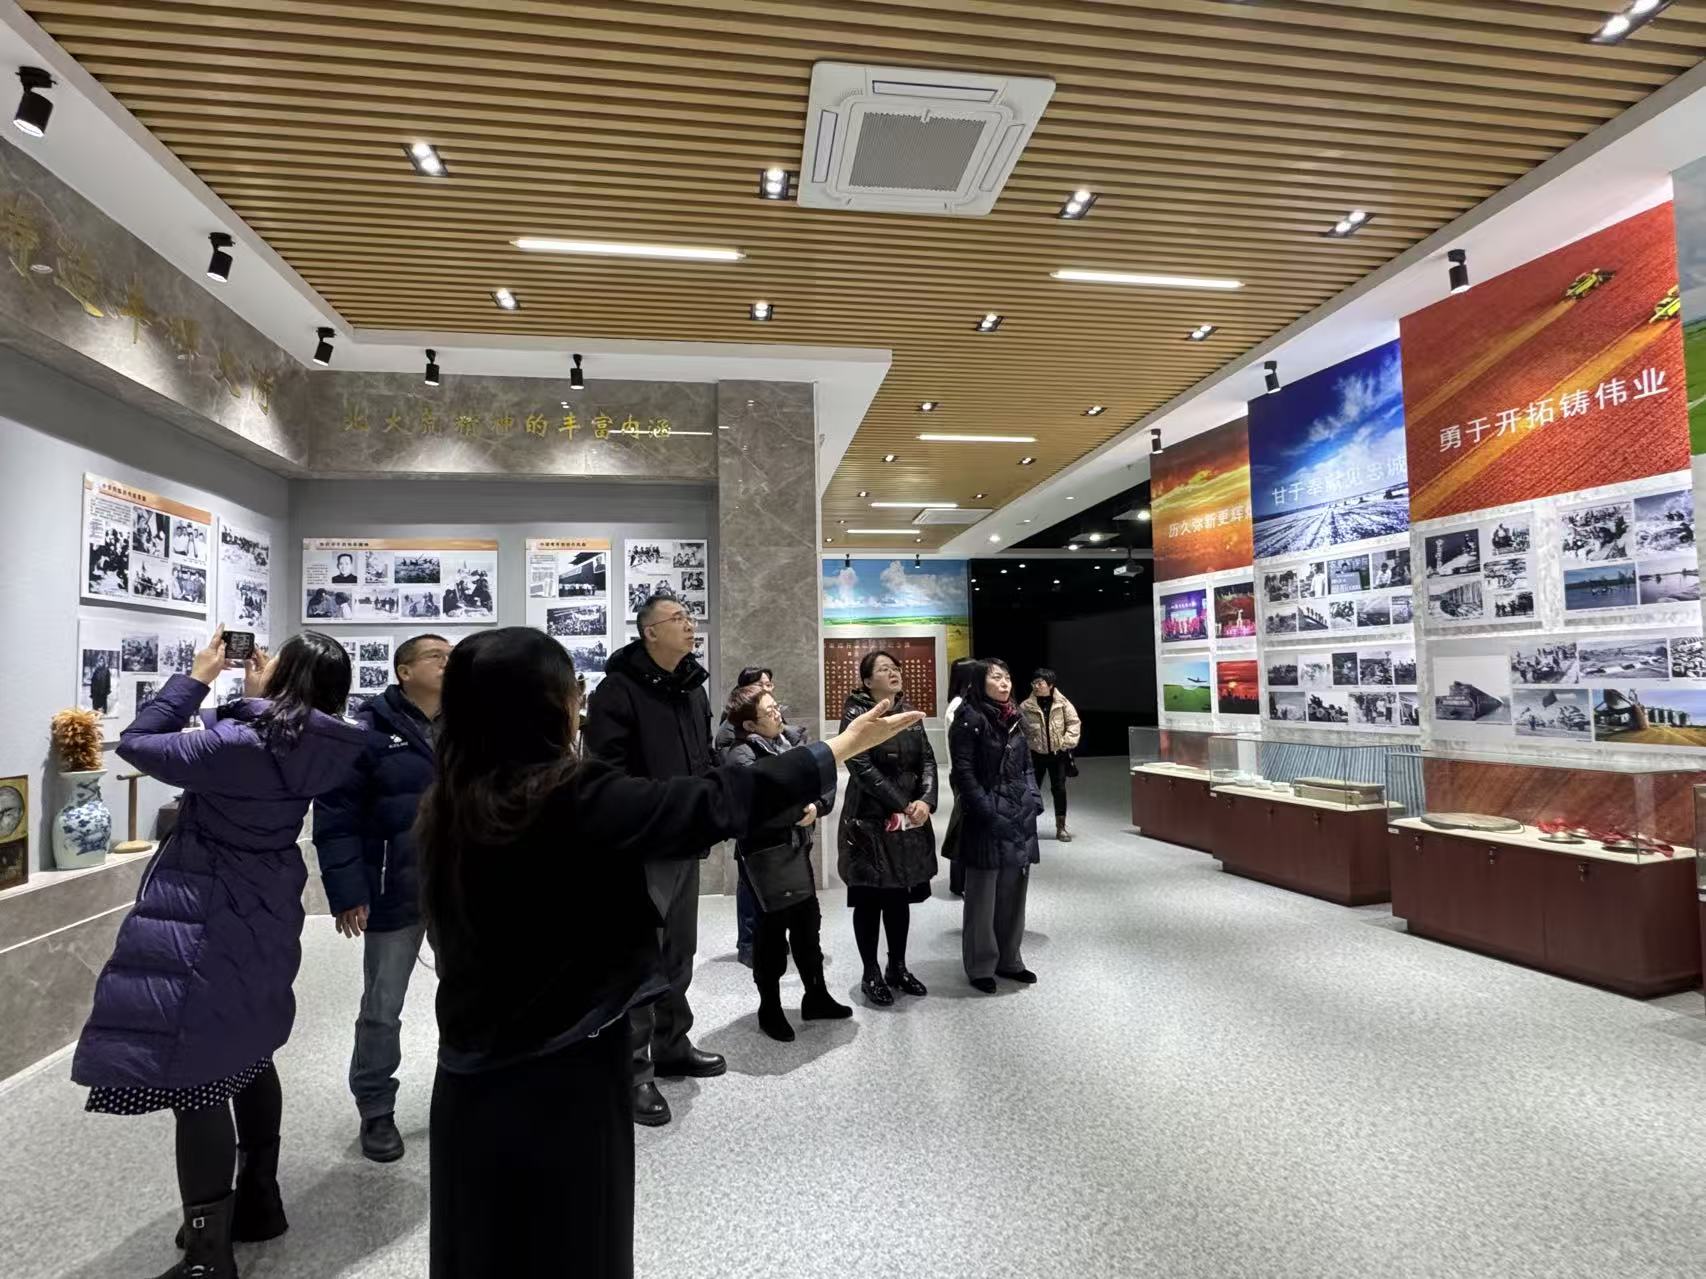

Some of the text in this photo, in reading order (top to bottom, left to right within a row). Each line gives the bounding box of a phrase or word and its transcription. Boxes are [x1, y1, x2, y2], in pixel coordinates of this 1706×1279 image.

[1439, 367, 1668, 452] 勇于开拓铸伟业
